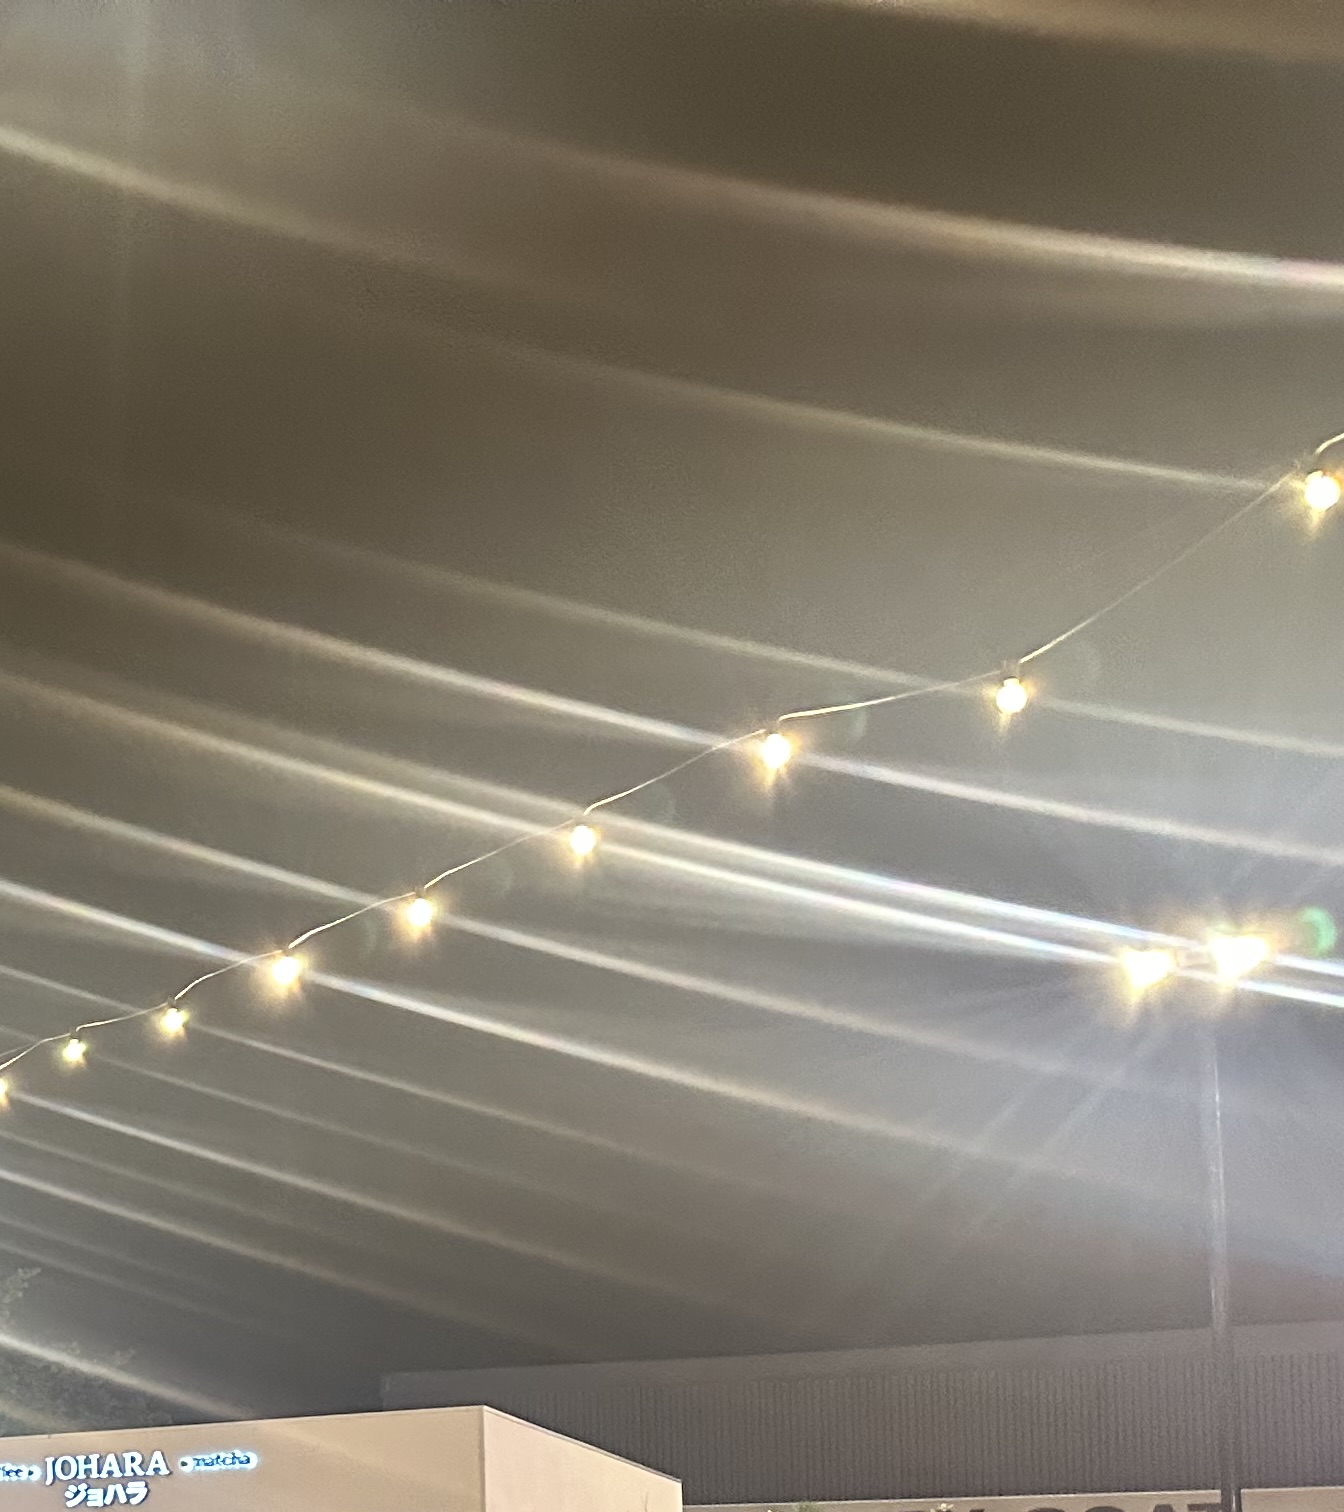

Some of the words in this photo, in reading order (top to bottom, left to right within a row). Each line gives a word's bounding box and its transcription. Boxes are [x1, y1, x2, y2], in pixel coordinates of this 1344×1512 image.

[44, 1450, 173, 1486] JOHARA
[64, 1481, 150, 1509] ジョハラ
